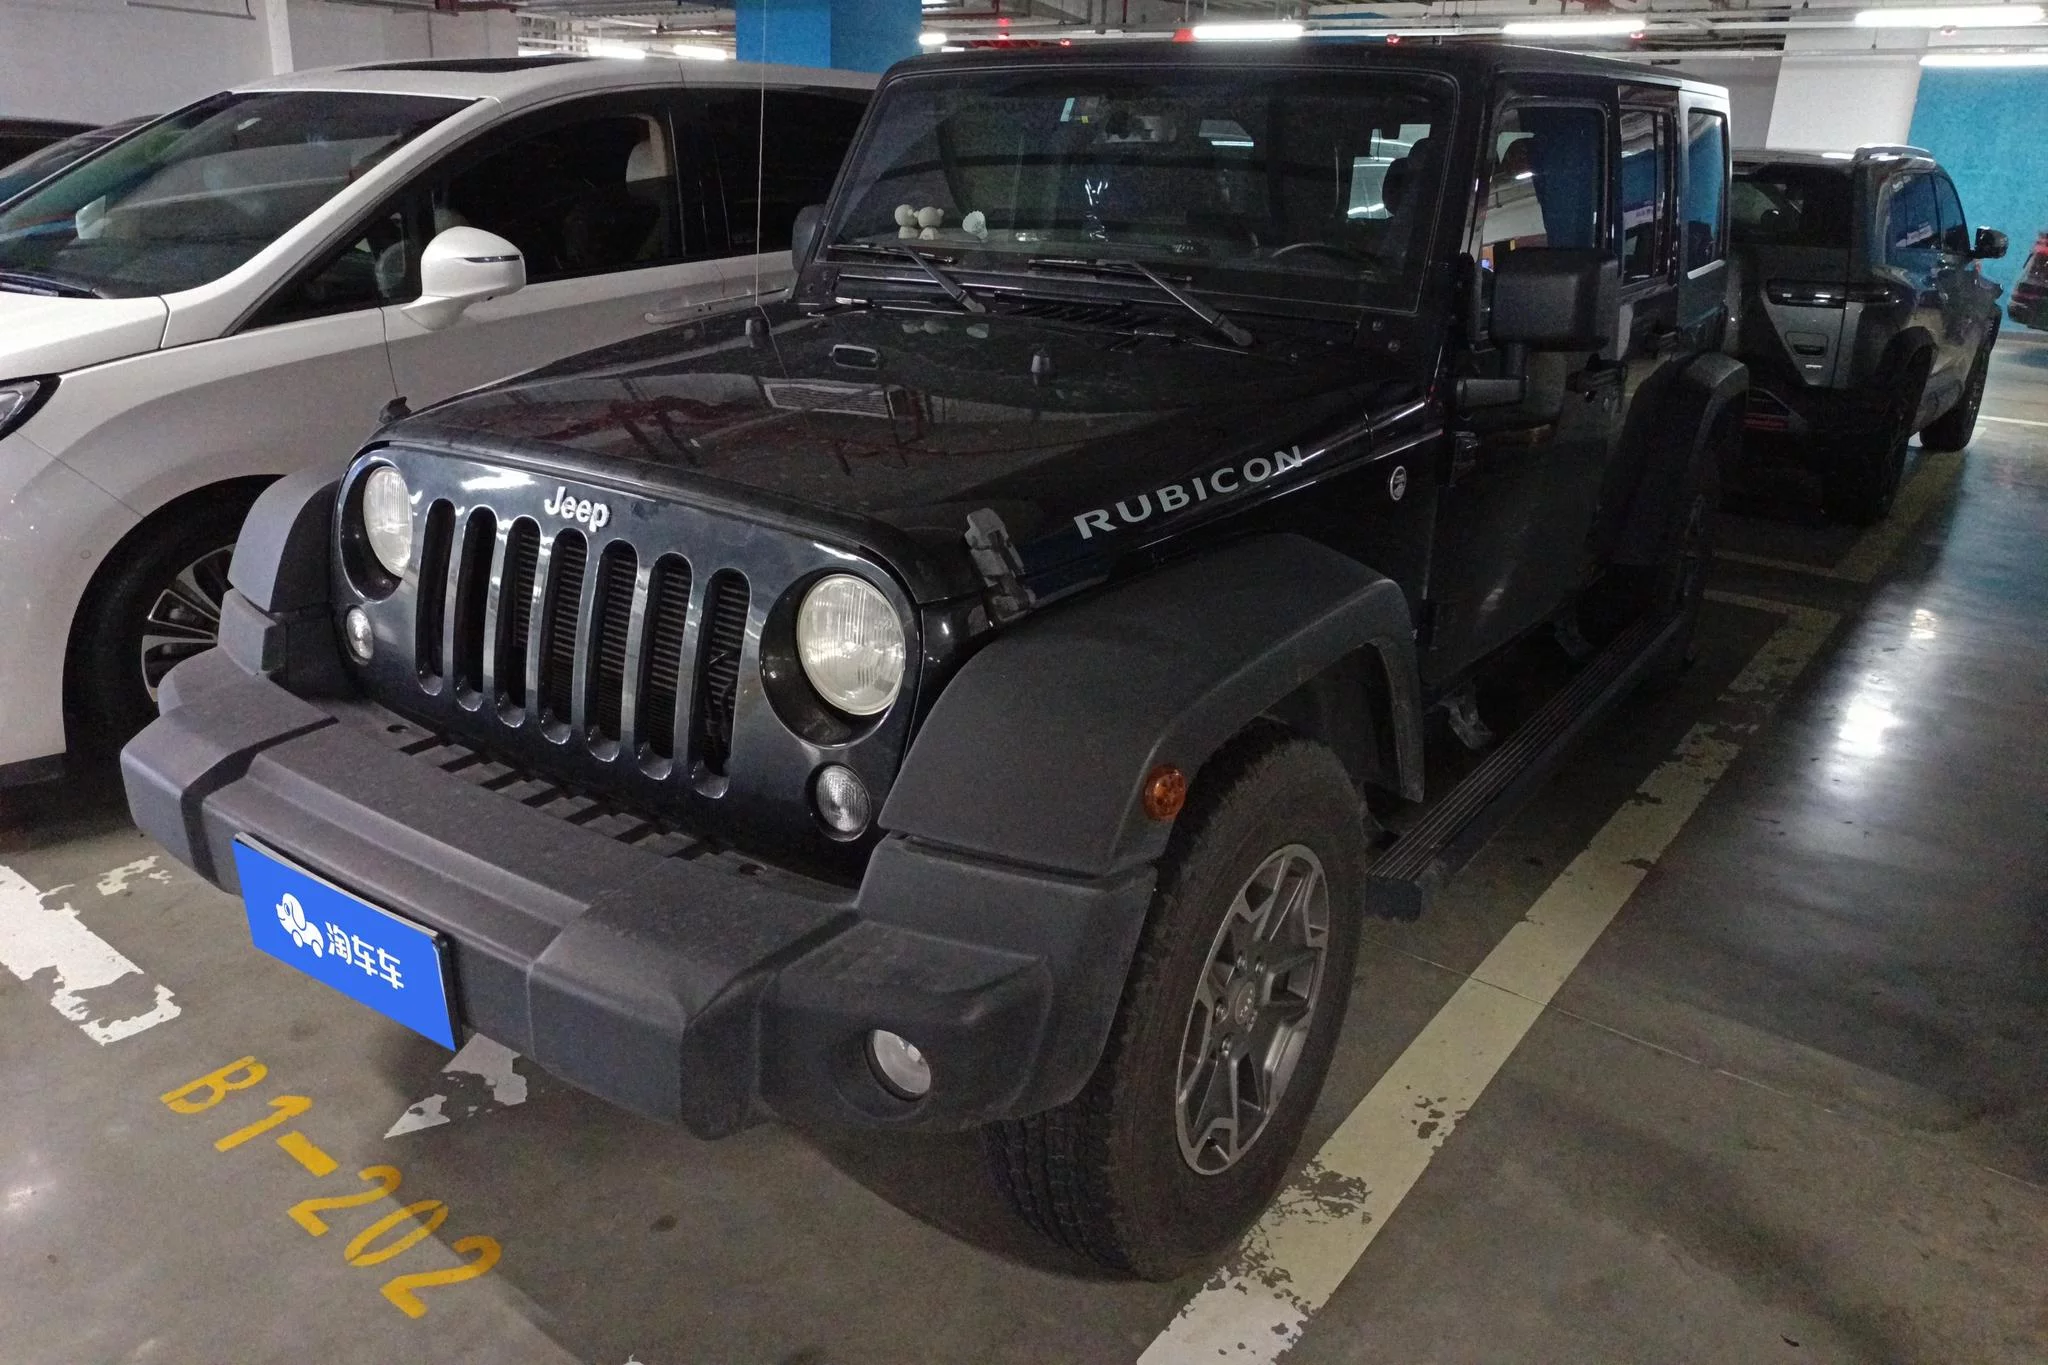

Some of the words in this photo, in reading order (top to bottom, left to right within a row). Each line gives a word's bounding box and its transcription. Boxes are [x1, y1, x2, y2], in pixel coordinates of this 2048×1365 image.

[543, 486, 610, 533] Jeep
[1073, 445, 1303, 540] RUBICON
[159, 1055, 502, 1319] B1-202
